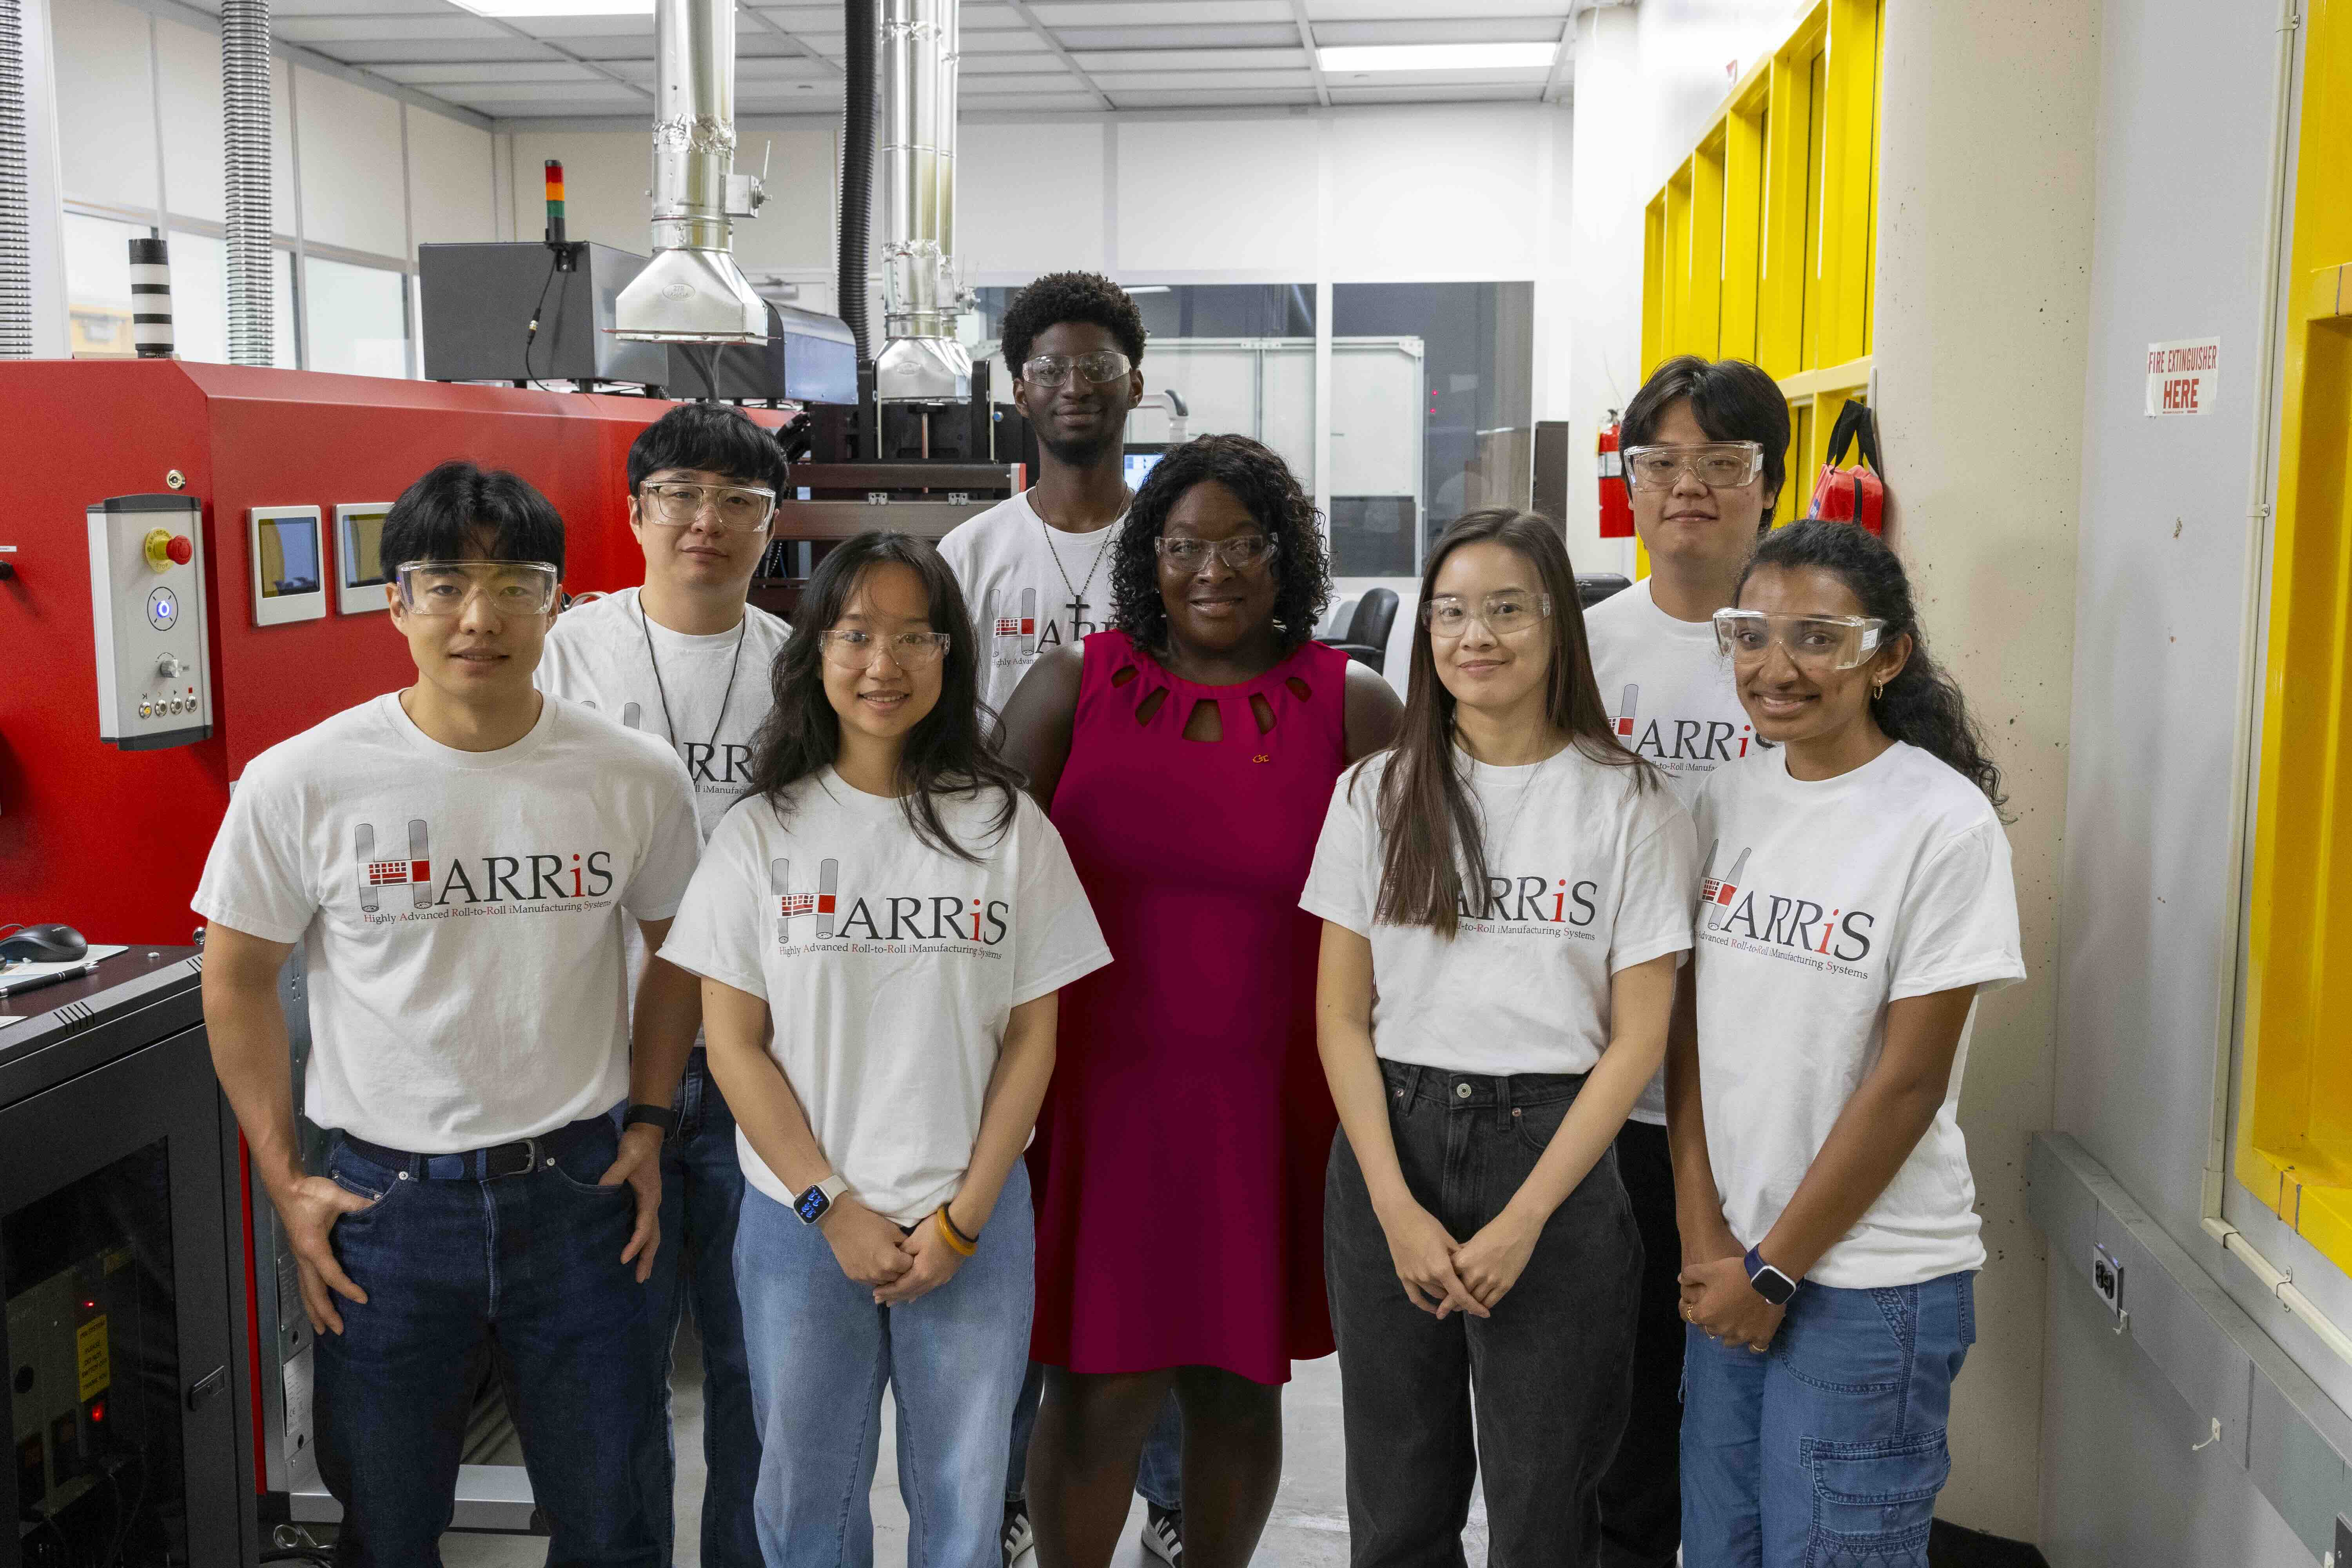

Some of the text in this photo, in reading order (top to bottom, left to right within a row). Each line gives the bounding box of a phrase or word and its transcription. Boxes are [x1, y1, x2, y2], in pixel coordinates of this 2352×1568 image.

[2148, 345, 2217, 374] FIRE EXTINGUISHER
[2163, 378, 2199, 409] HERE
[364, 898, 612, 925] Highly Advanced Roll-to-Roll iManufacturing Systems
[1497, 924, 1561, 938] iManufacturing
[1564, 927, 1595, 941] Systems
[778, 942, 1002, 960] Highly Advanced Roll-to-Roll iManufacturing Systems
[1731, 938, 1769, 956] Roll-to-Roll
[1769, 949, 1824, 971] iManufacturing
[1826, 961, 1868, 980] Systems
